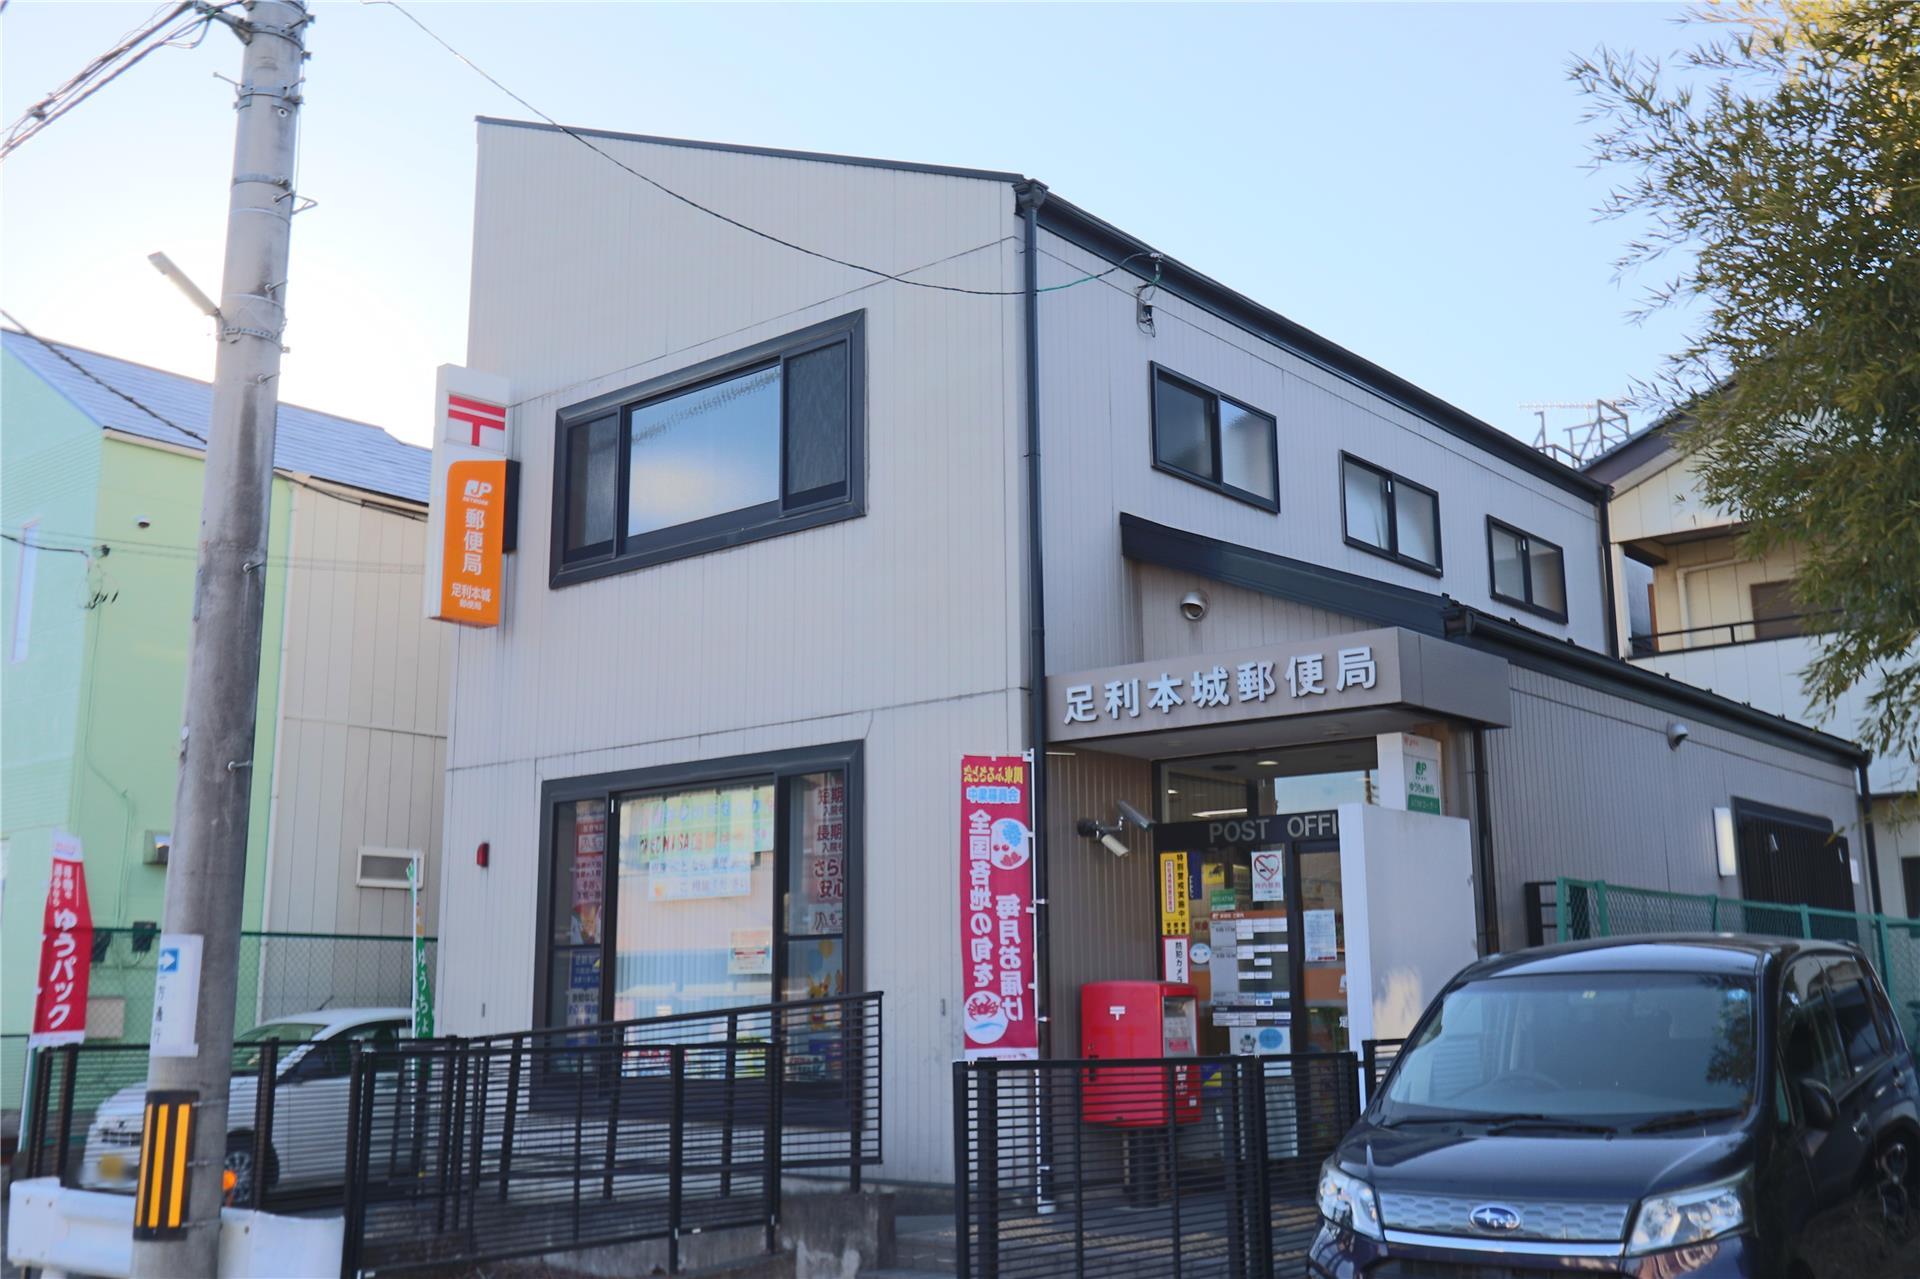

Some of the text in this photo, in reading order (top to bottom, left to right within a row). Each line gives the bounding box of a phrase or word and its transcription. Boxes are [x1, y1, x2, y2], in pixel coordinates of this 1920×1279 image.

[463, 509, 484, 576] 郵便局
[451, 582, 492, 602] 足利本城
[1064, 646, 1377, 726] 足利本城郵便局
[816, 823, 843, 842] 長期
[1209, 814, 1337, 844] POST OFFI
[818, 879, 843, 898] 安心
[47, 907, 78, 1030] ゆうパック
